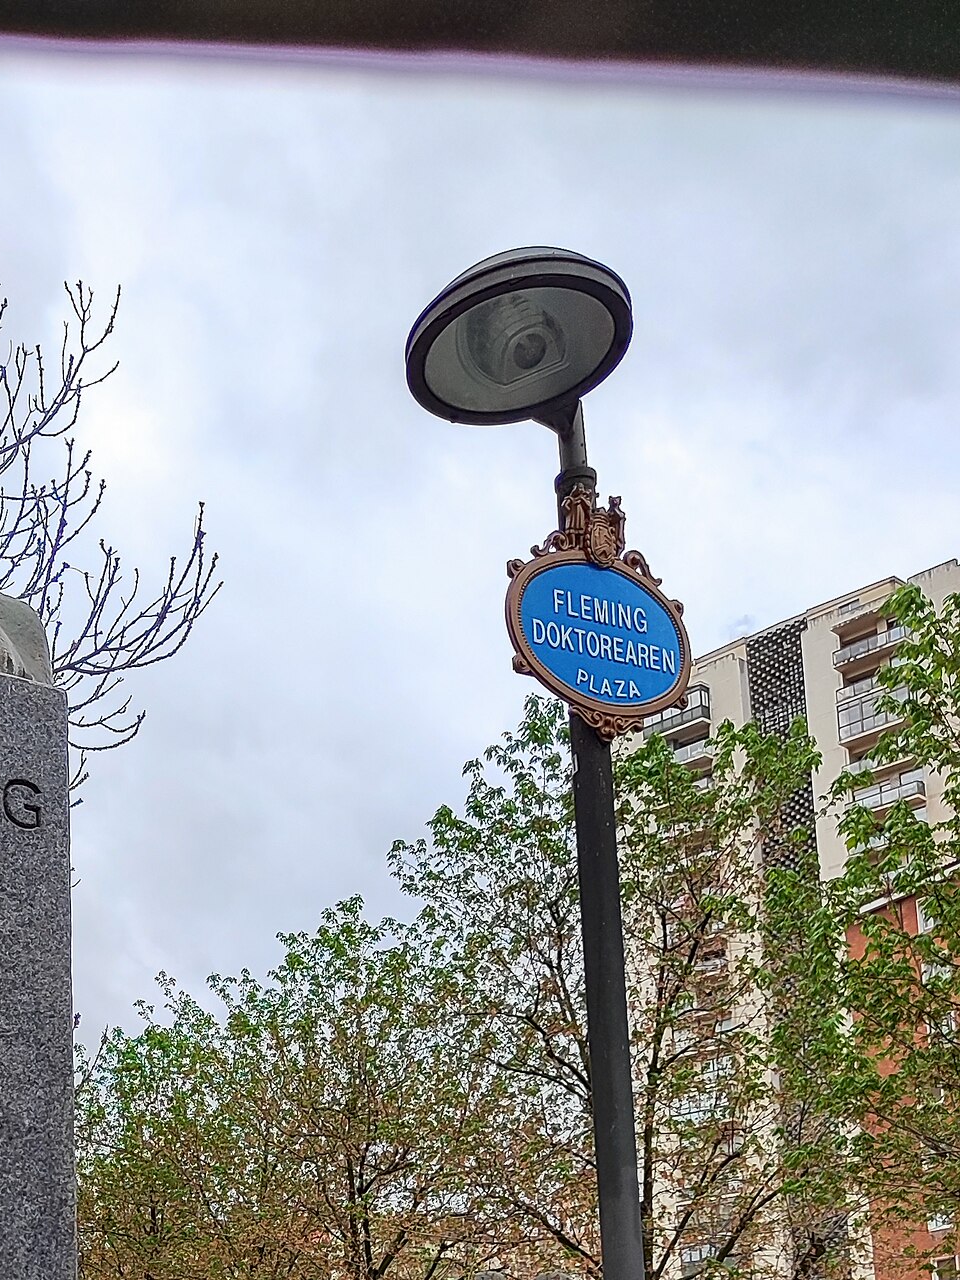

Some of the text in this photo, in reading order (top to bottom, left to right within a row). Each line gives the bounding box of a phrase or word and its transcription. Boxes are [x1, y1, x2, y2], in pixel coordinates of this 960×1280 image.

[553, 589, 648, 633] FLEMING
[532, 618, 676, 674] DOKTOREAREN
[576, 668, 642, 698] PLAZA
